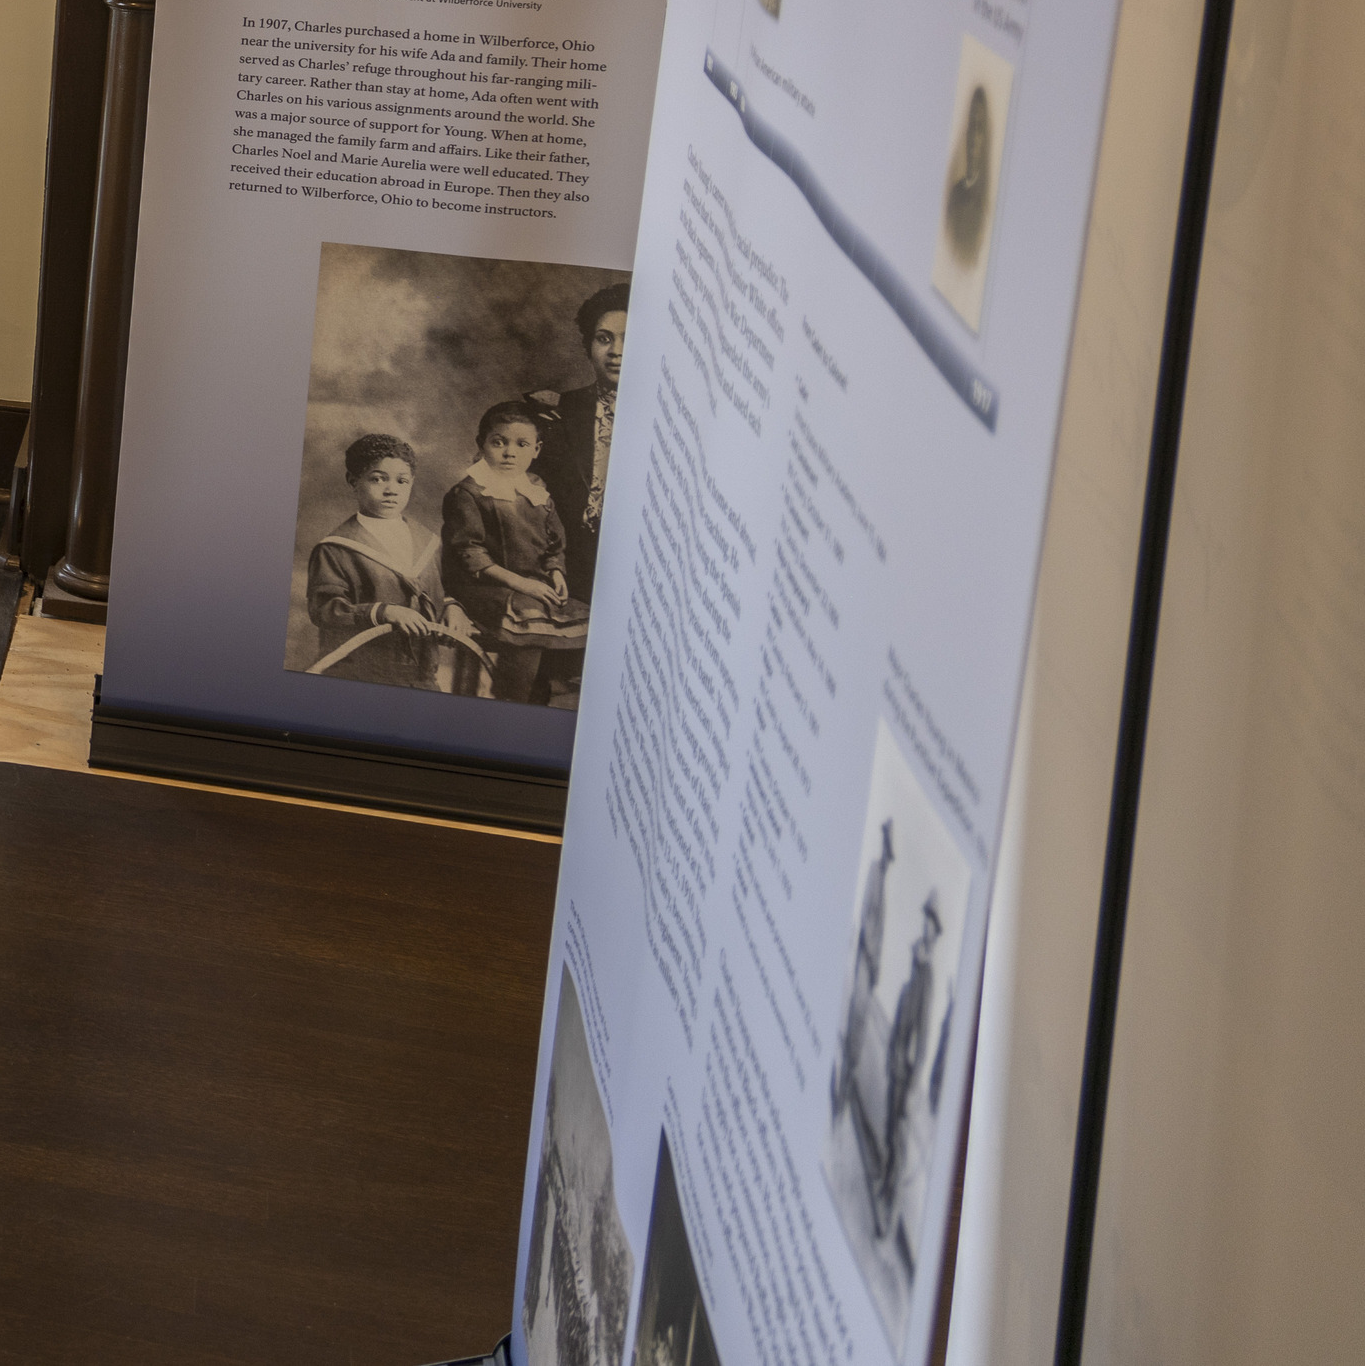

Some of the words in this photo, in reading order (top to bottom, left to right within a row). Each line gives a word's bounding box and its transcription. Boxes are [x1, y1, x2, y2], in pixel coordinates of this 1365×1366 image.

[242, 17, 255, 28] In
[259, 18, 291, 32] 1907,
[293, 21, 342, 34] Charles
[344, 26, 410, 39] purchased
[412, 32, 420, 40] a
[422, 30, 460, 43] home
[462, 33, 475, 44] in
[478, 34, 558, 51] Wilberforce,
[561, 40, 595, 52] Ohio
